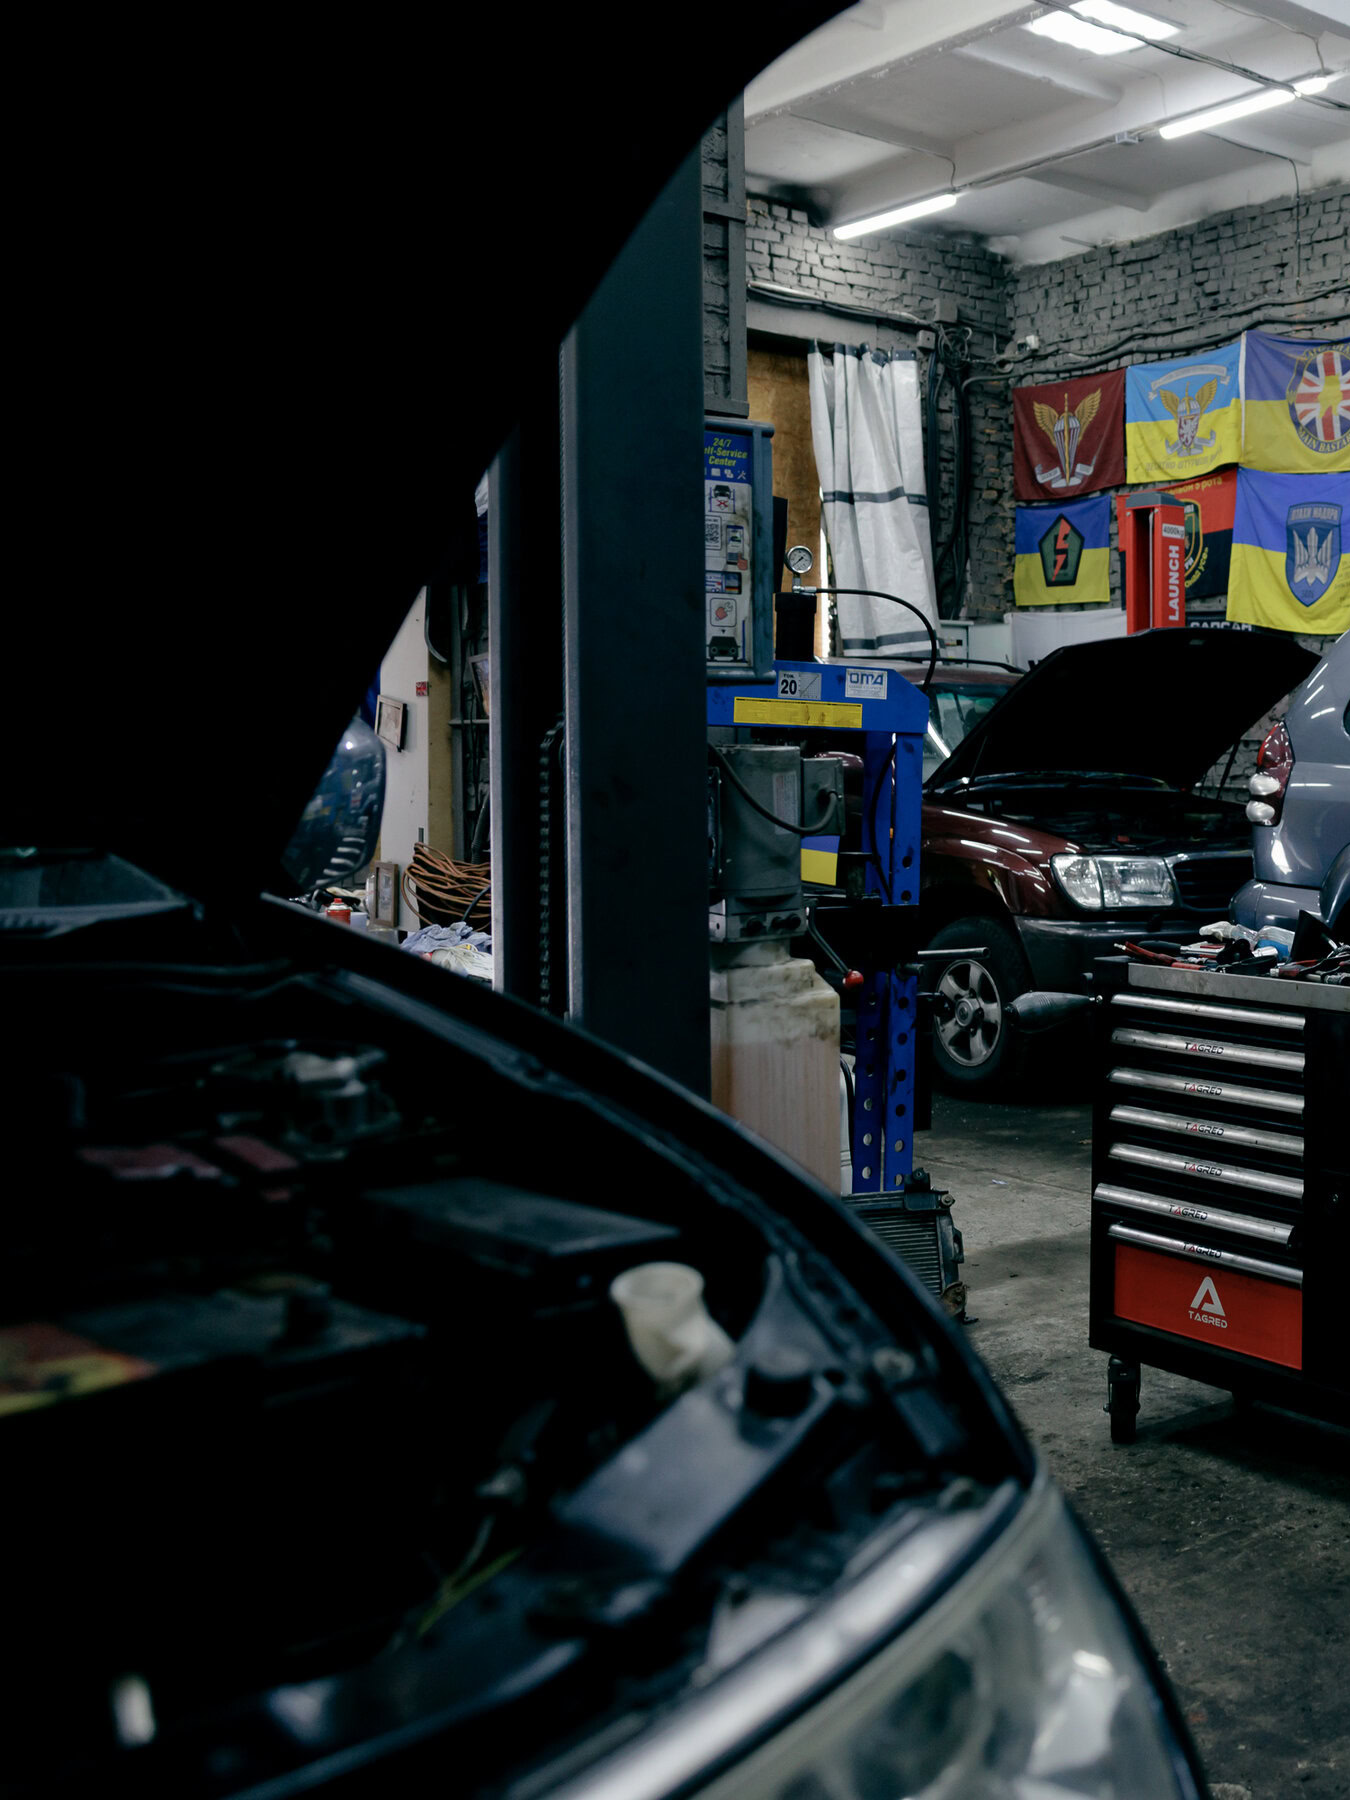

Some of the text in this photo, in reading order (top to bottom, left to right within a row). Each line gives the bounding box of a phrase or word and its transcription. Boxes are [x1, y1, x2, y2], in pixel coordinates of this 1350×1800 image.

[713, 437, 732, 448] 24/7
[708, 455, 737, 467] Center
[1168, 545, 1180, 622] LAUNCH
[780, 679, 797, 695] 20
[1184, 1042, 1225, 1055] TAGRED
[1183, 1082, 1223, 1096] TAGRED
[1184, 1122, 1225, 1136] TAGRED
[1183, 1162, 1223, 1177] TAGRED
[1169, 1204, 1209, 1221] TAGRED
[1183, 1243, 1222, 1259] TAGRED
[1188, 1310, 1228, 1329] TAGRED
